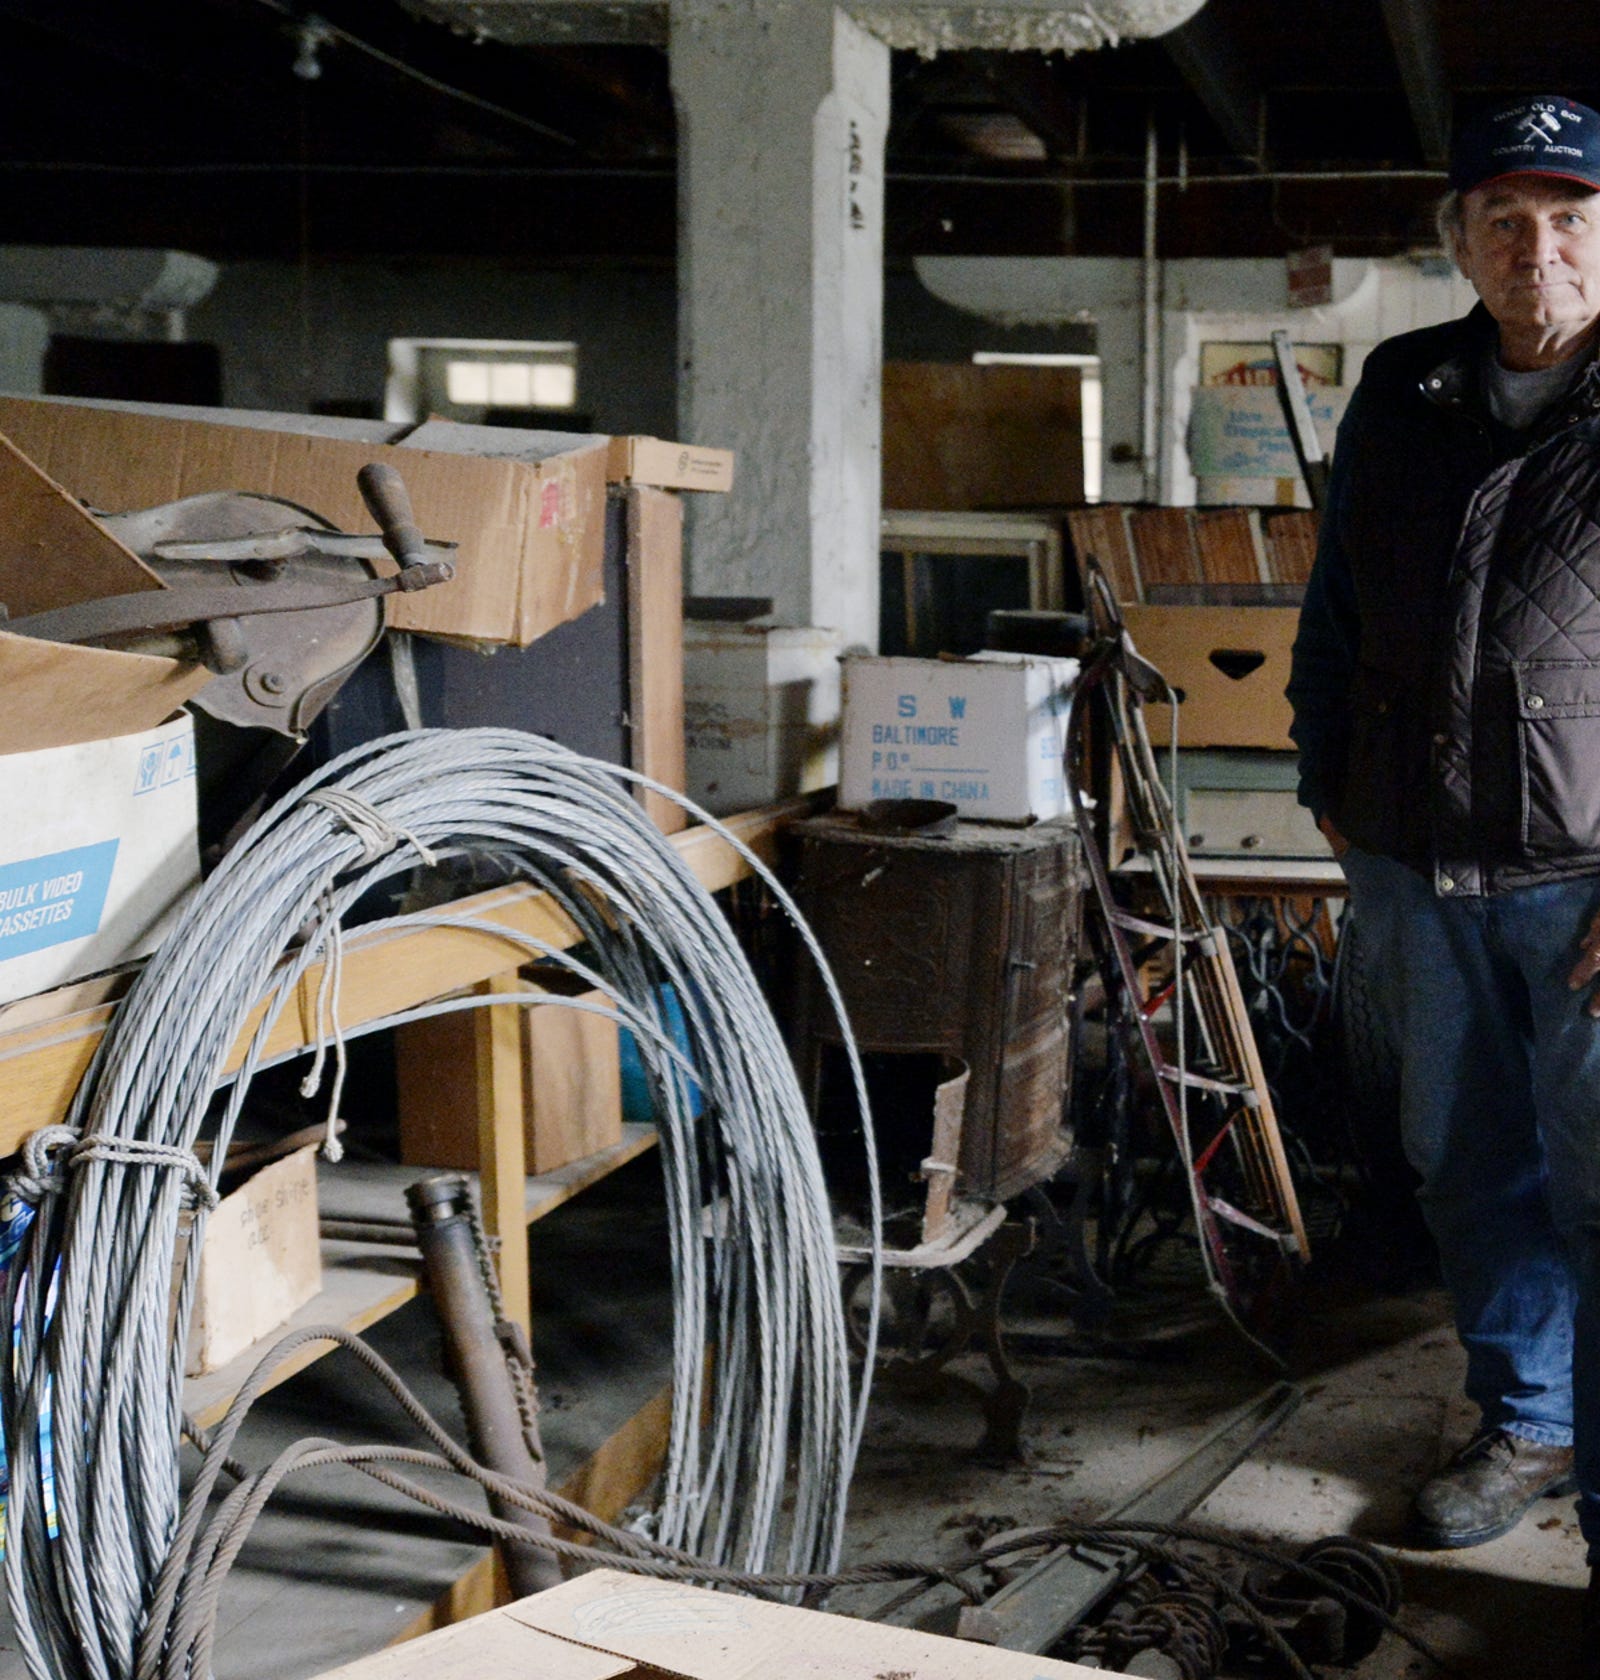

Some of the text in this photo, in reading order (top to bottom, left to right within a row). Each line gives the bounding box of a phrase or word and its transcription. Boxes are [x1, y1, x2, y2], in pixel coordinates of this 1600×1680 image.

[1531, 102, 1556, 113] OLD
[1560, 109, 1583, 123] BOY
[1492, 144, 1584, 158] COUNTRY AUCTION
[897, 694, 968, 719] S W
[872, 724, 960, 747] BALTIMORE
[872, 778, 990, 801] MADE IN CHINA
[42, 870, 84, 901] VIDEO
